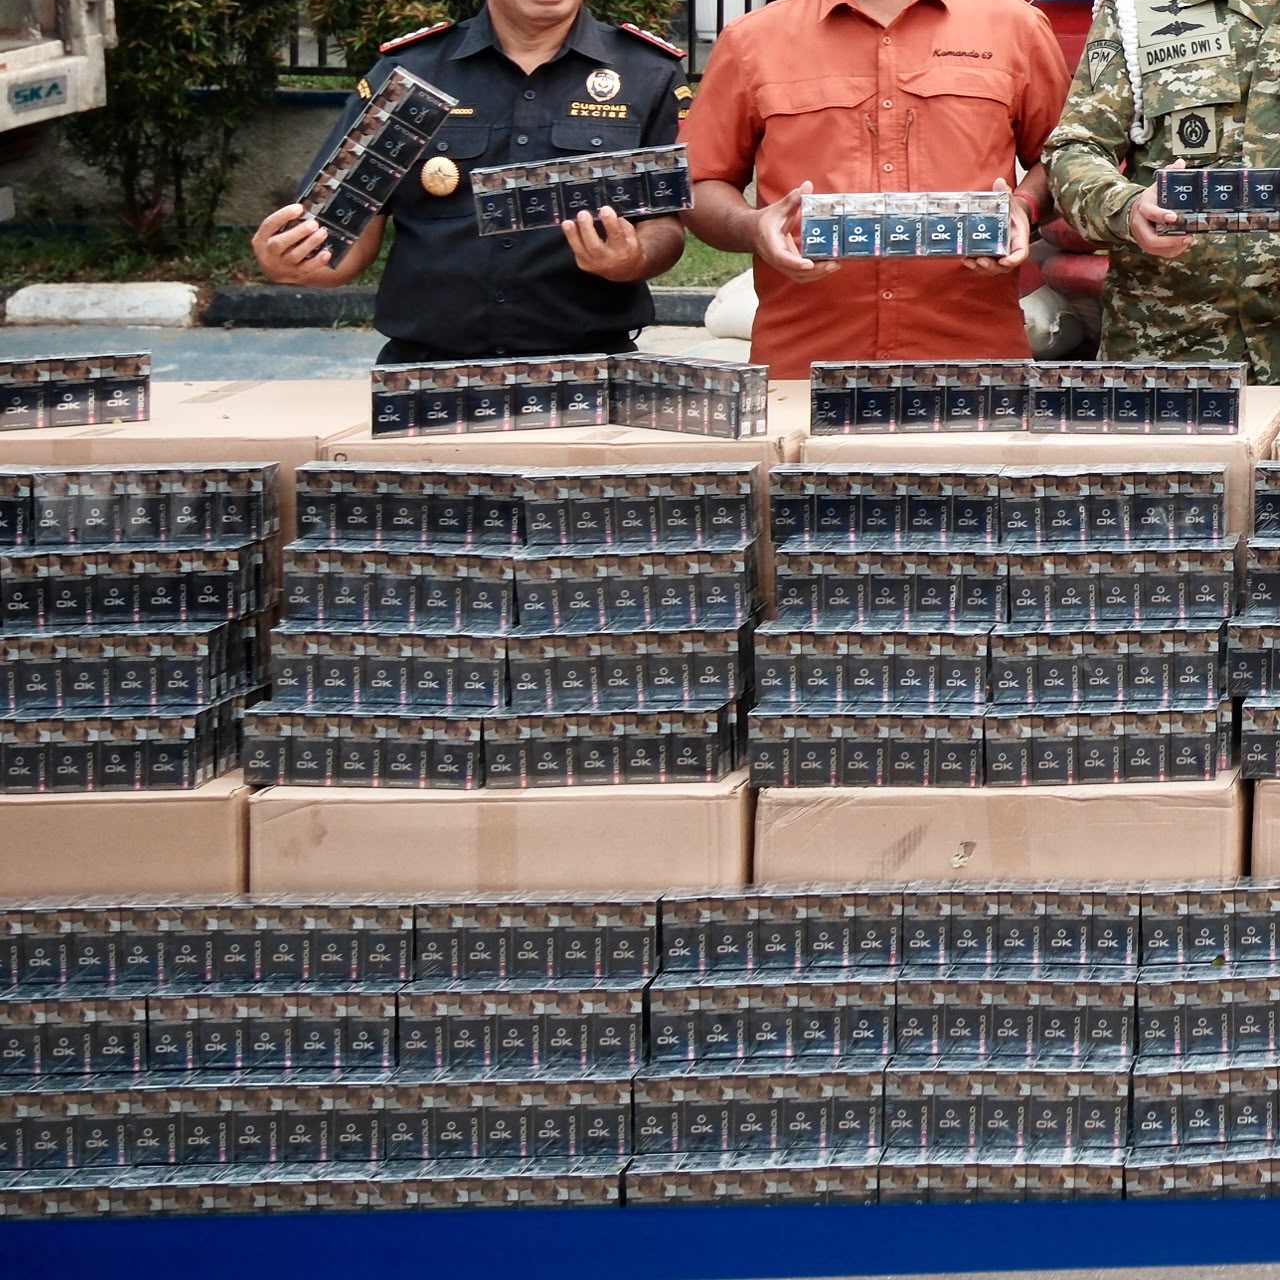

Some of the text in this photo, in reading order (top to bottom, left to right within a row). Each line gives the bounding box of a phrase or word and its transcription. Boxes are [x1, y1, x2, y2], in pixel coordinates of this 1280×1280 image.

[932, 48, 993, 60] Komando 69
[1090, 50, 1111, 64] PM
[1146, 37, 1222, 66] DADANG DWI S
[571, 101, 628, 111] CUSTOMS
[570, 109, 627, 118] EXCISE
